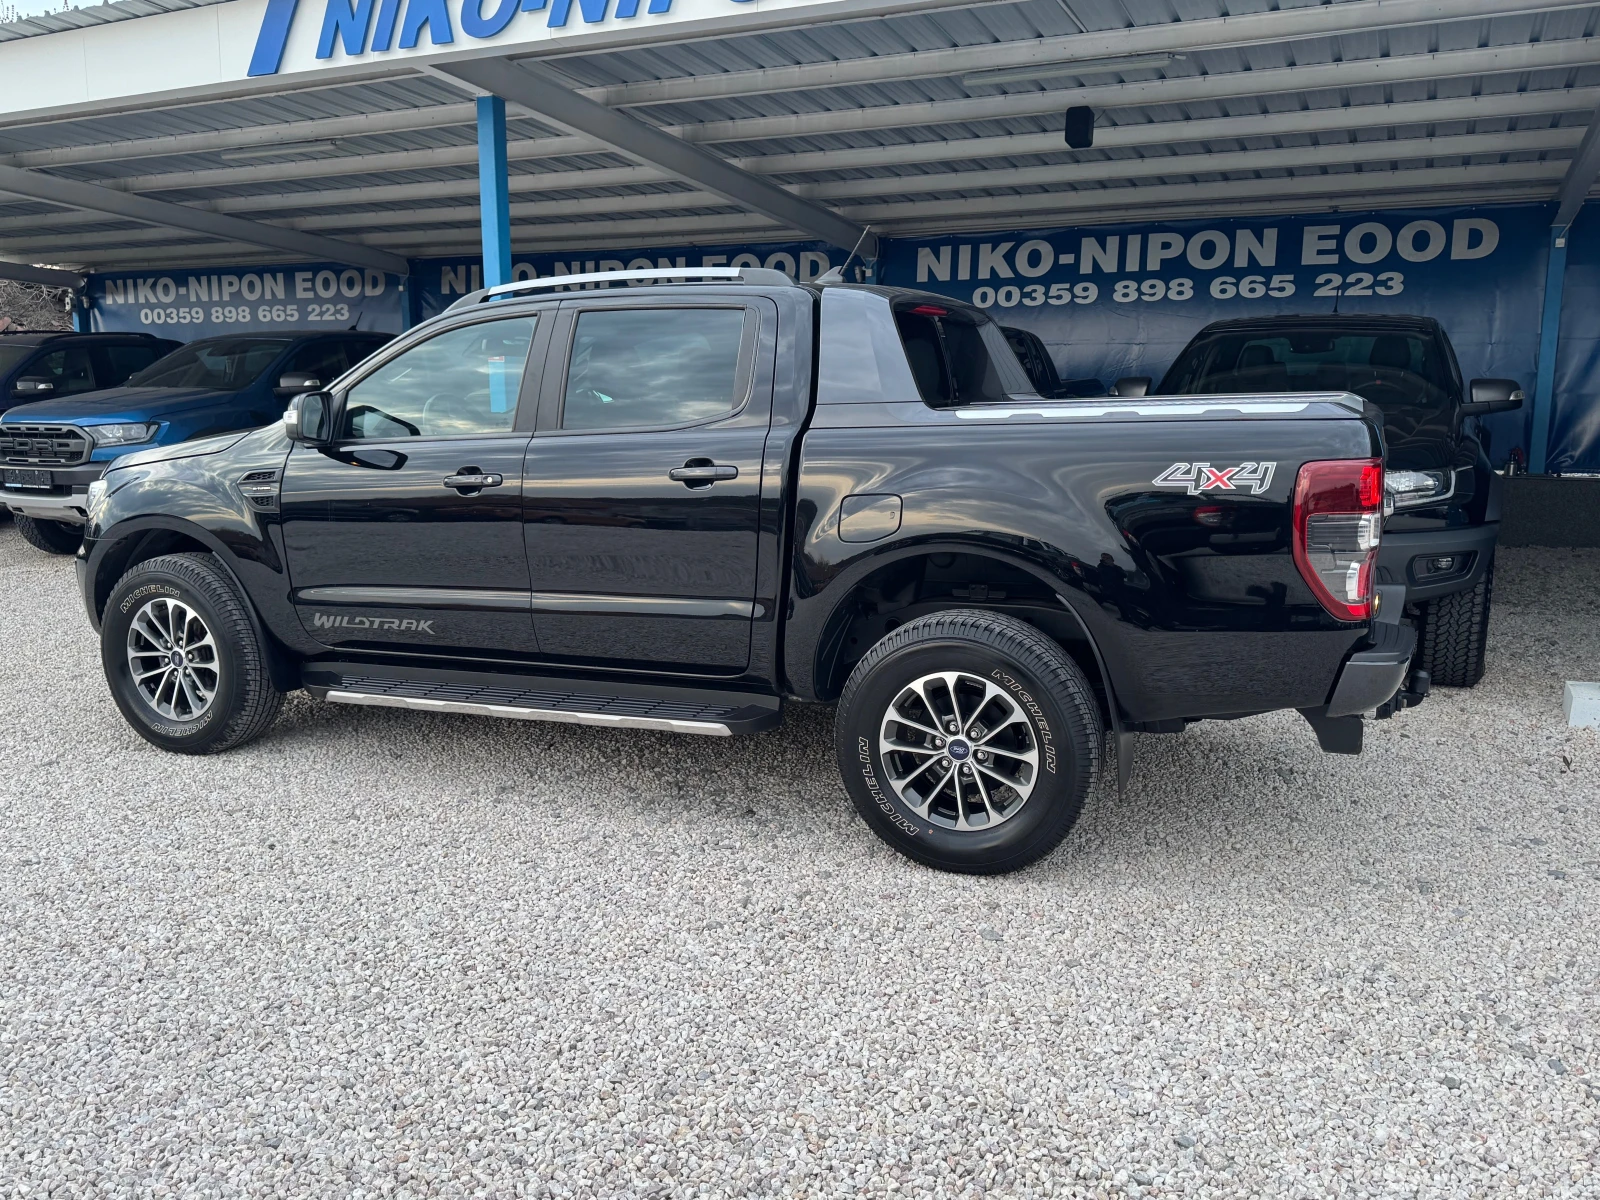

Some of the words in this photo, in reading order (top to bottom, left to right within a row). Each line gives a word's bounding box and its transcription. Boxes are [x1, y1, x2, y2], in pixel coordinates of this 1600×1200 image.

[916, 228, 1278, 282] NIKO-NIPON
[1301, 218, 1500, 265] EOOD
[105, 273, 285, 304] NIKO-NIPON
[295, 269, 386, 299] EOOD
[441, 256, 686, 294] NIO-NIPON
[972, 282, 1099, 309] 00359
[1112, 278, 1194, 303] 898
[1209, 274, 1296, 299] 665
[1313, 272, 1405, 297] 223
[140, 307, 204, 325] 00359
[211, 306, 251, 322] 898
[258, 305, 299, 321] 665
[307, 304, 350, 321] 223
[120, 585, 181, 613] MICHELIN
[313, 612, 436, 635] WILDTRAK
[991, 668, 1056, 774] MICHELIN
[858, 737, 919, 836] MICHELIN
